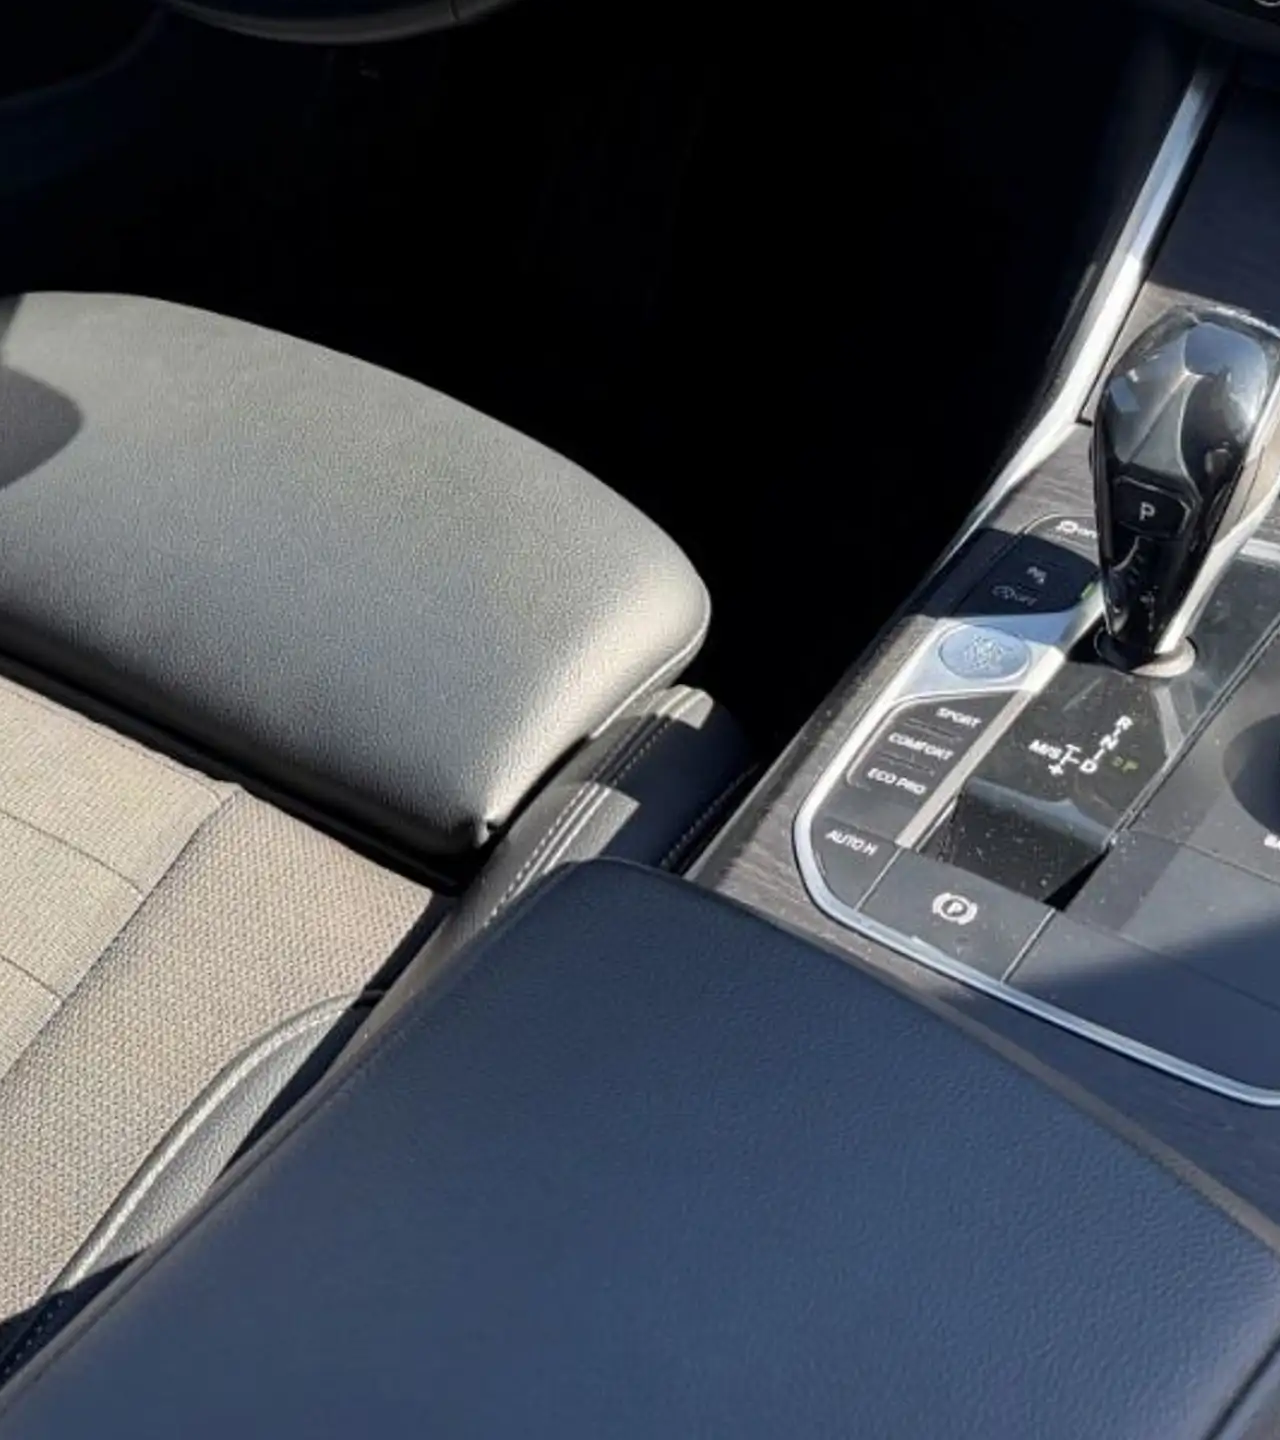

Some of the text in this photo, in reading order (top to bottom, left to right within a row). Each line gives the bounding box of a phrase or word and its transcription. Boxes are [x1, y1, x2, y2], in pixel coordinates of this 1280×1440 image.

[1138, 501, 1156, 522] P
[935, 707, 982, 729] SPORT
[1115, 715, 1134, 731] R
[888, 732, 955, 761] COMFORT
[1028, 739, 1062, 760] M/S
[1099, 734, 1119, 751] N
[1079, 758, 1098, 774] D
[867, 767, 927, 795] ECO PRO
[825, 829, 865, 852] AUTO
